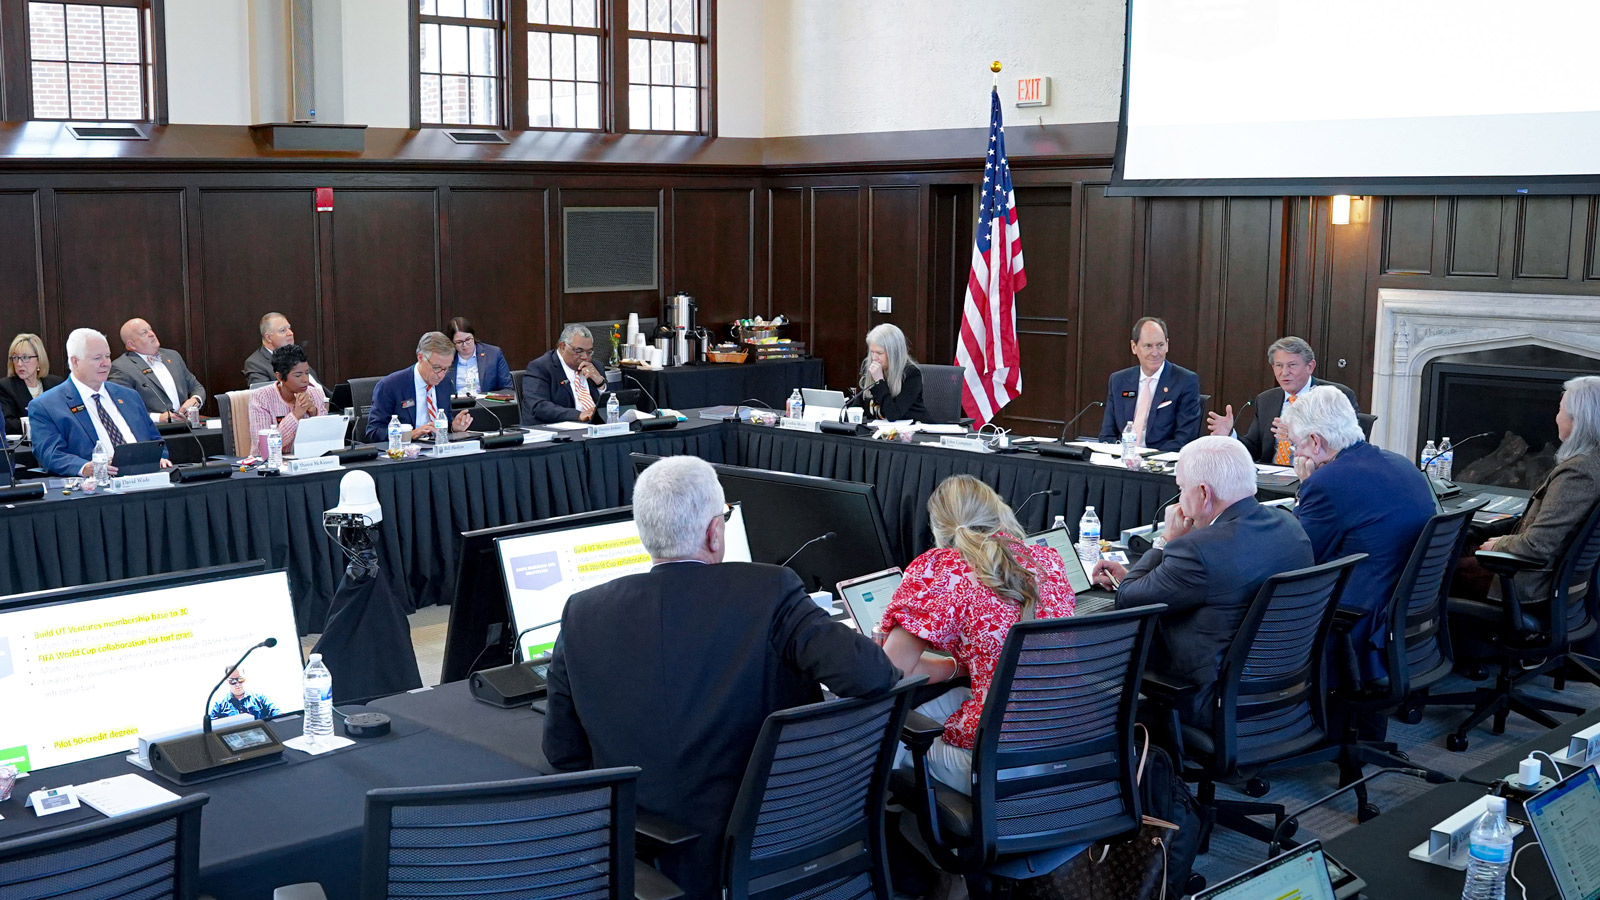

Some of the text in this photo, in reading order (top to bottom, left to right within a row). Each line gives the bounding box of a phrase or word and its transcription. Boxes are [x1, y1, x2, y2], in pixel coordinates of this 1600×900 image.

[1018, 78, 1041, 101] EXIT
[619, 538, 641, 548] member
[34, 628, 54, 639] Build
[55, 627, 66, 636] UT
[68, 623, 102, 634] Ventures
[103, 615, 150, 628] membership
[151, 612, 168, 620] base
[170, 609, 178, 617] to
[38, 632, 194, 663] FIFA World Cup collaboration for turf grass
[54, 727, 139, 749] Pilot 90-credit degrees
